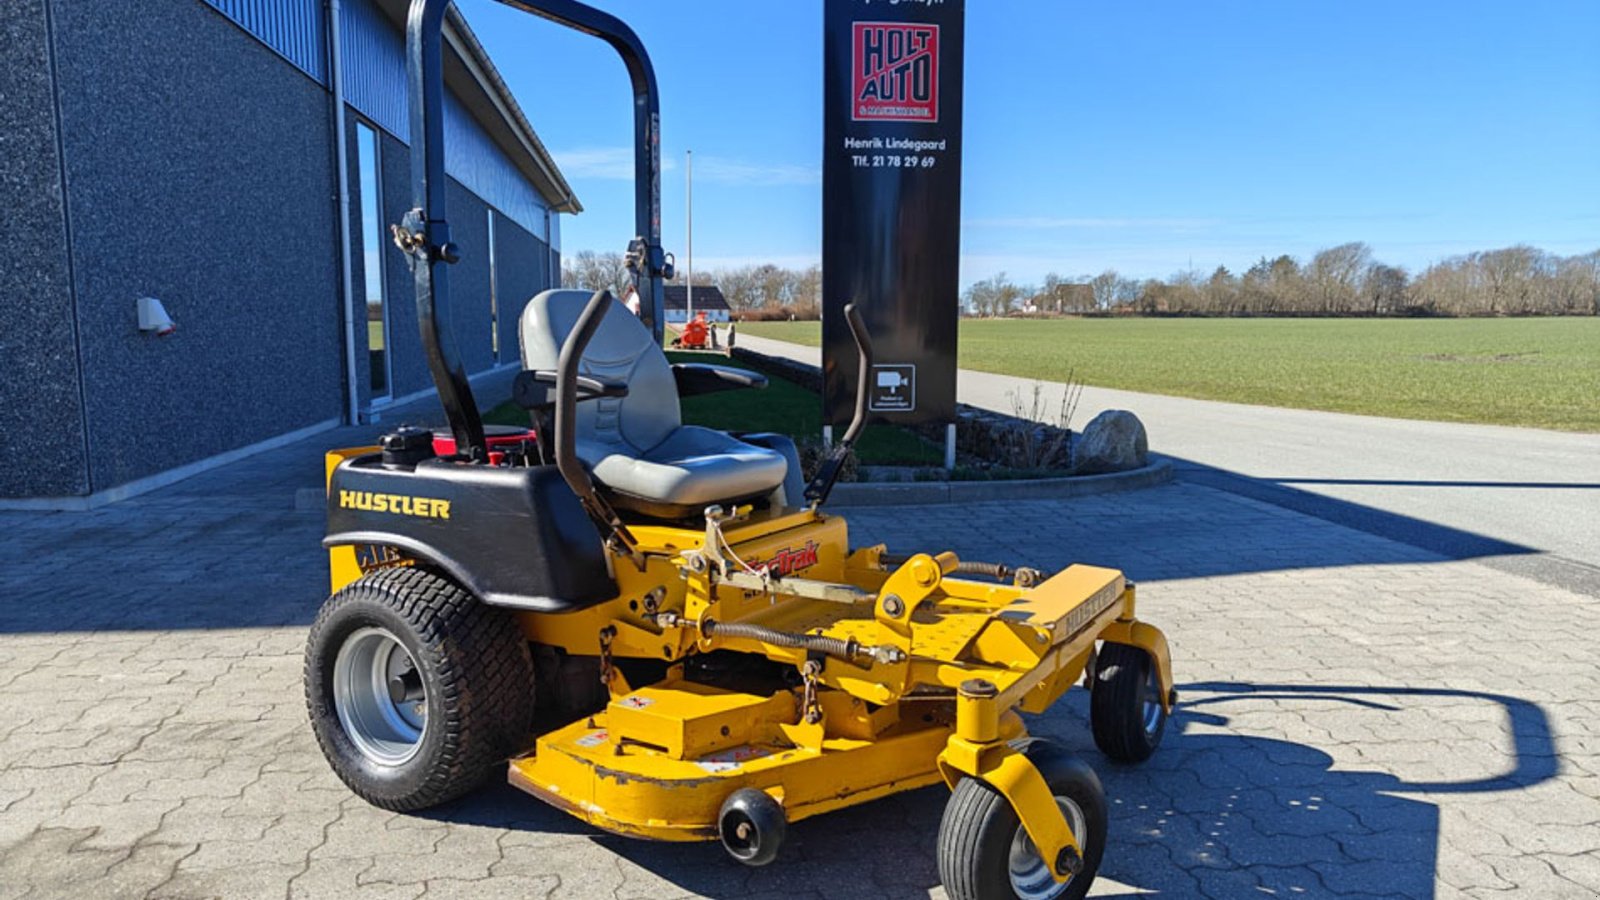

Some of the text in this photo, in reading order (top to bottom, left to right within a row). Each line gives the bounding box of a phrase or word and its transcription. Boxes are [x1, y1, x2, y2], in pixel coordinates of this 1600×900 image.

[862, 27, 932, 79] HOLT
[859, 52, 931, 102] AUTO
[844, 137, 946, 152] Henrik Lindegaard
[852, 155, 936, 167] Tlf. 21 78 29 69
[340, 489, 451, 519] HUSTLER
